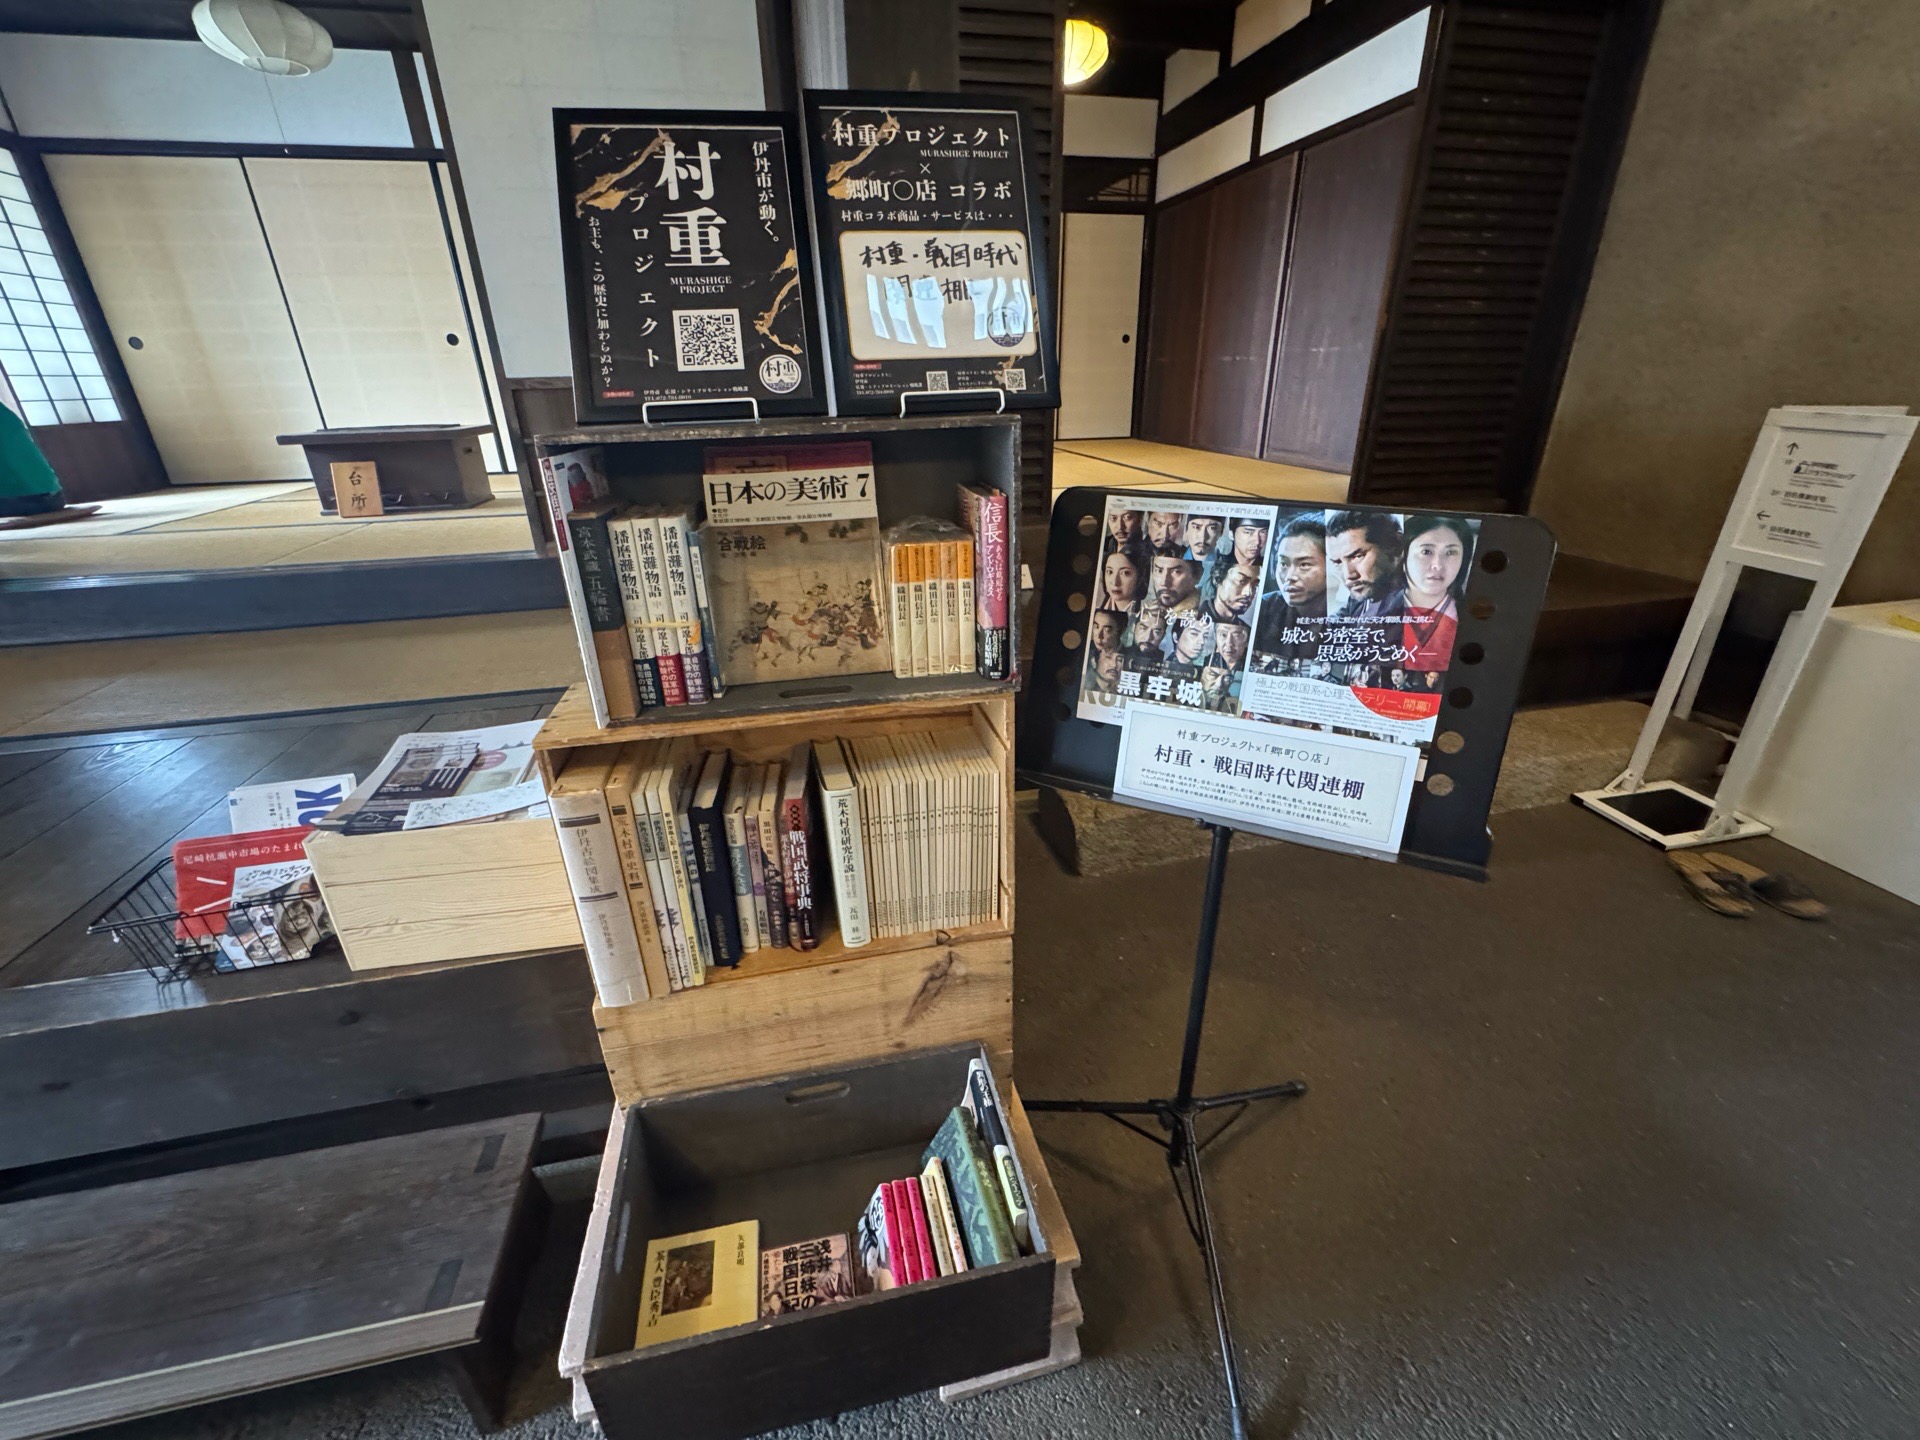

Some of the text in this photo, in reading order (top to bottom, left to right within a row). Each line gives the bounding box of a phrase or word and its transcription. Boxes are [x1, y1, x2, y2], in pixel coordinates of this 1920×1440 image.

[832, 123, 1011, 147] 村重プロジェクト
[920, 149, 1009, 159] MURASHIGE PROJECT
[653, 140, 731, 267] 村重
[751, 141, 780, 243] 伊丹市が動く。
[949, 181, 1013, 201] コラボ
[860, 237, 1023, 269] 村重・戦国時代
[630, 192, 660, 368] プロジェクト
[670, 275, 732, 286] MURASHIGE
[680, 284, 726, 294] PROJECT
[349, 471, 367, 508] 台所
[709, 473, 869, 506] 日本の美術 7
[984, 501, 1004, 544] 信長
[718, 536, 766, 551] 合戦絵
[1281, 626, 1386, 645] 城という密室で、
[1117, 670, 1204, 707] 黒牢城
[1154, 744, 1366, 801] 村重・戦国時代関連棚
[838, 798, 855, 873] 荒木村重研究序説
[789, 830, 813, 911] 戦国武将事典
[817, 1239, 833, 1273] 浅井
[782, 1249, 800, 1311] 戦国日記
[800, 1244, 818, 1309] 三姉妹の
